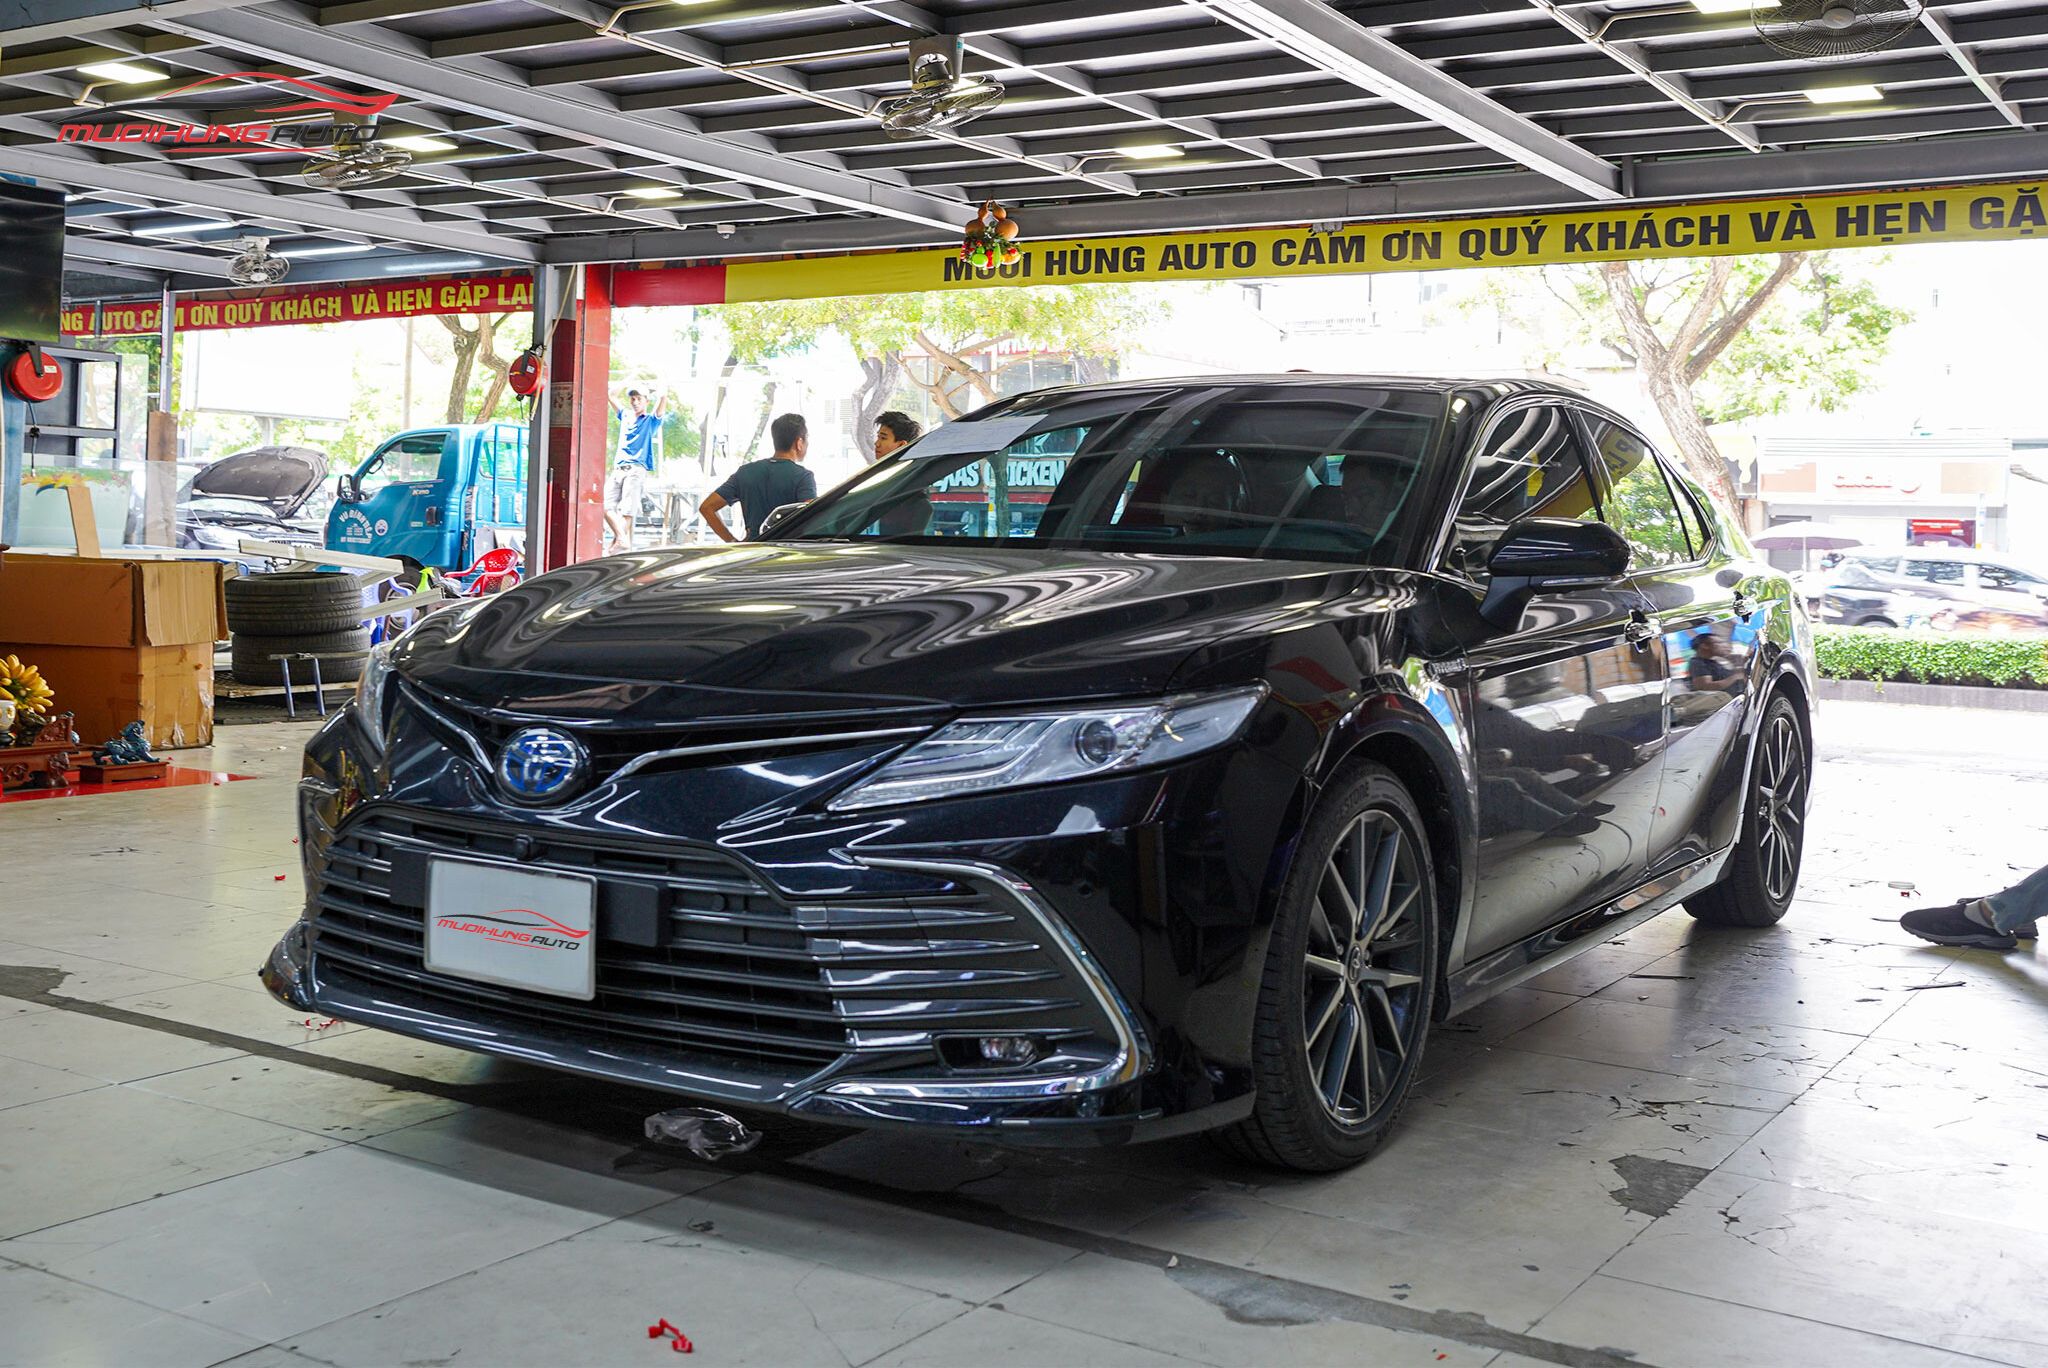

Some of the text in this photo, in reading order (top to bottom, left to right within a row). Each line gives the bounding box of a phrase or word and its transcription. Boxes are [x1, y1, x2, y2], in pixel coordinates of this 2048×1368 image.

[1044, 243, 1146, 277] HÙNG
[1158, 240, 1257, 272] AUTO
[1381, 229, 1442, 262] ƠN
[1458, 218, 1548, 261] QUÝ
[1564, 211, 1731, 253] KHÁCH
[1749, 202, 1817, 243] VÀ
[1836, 200, 1947, 243] HẸN
[190, 303, 219, 327] ƠN
[224, 297, 264, 327] QUÝ
[269, 294, 342, 322] KHÁCH
[351, 288, 381, 316] VÀ
[387, 287, 433, 316] HẸN
[440, 281, 490, 312] GẶP
